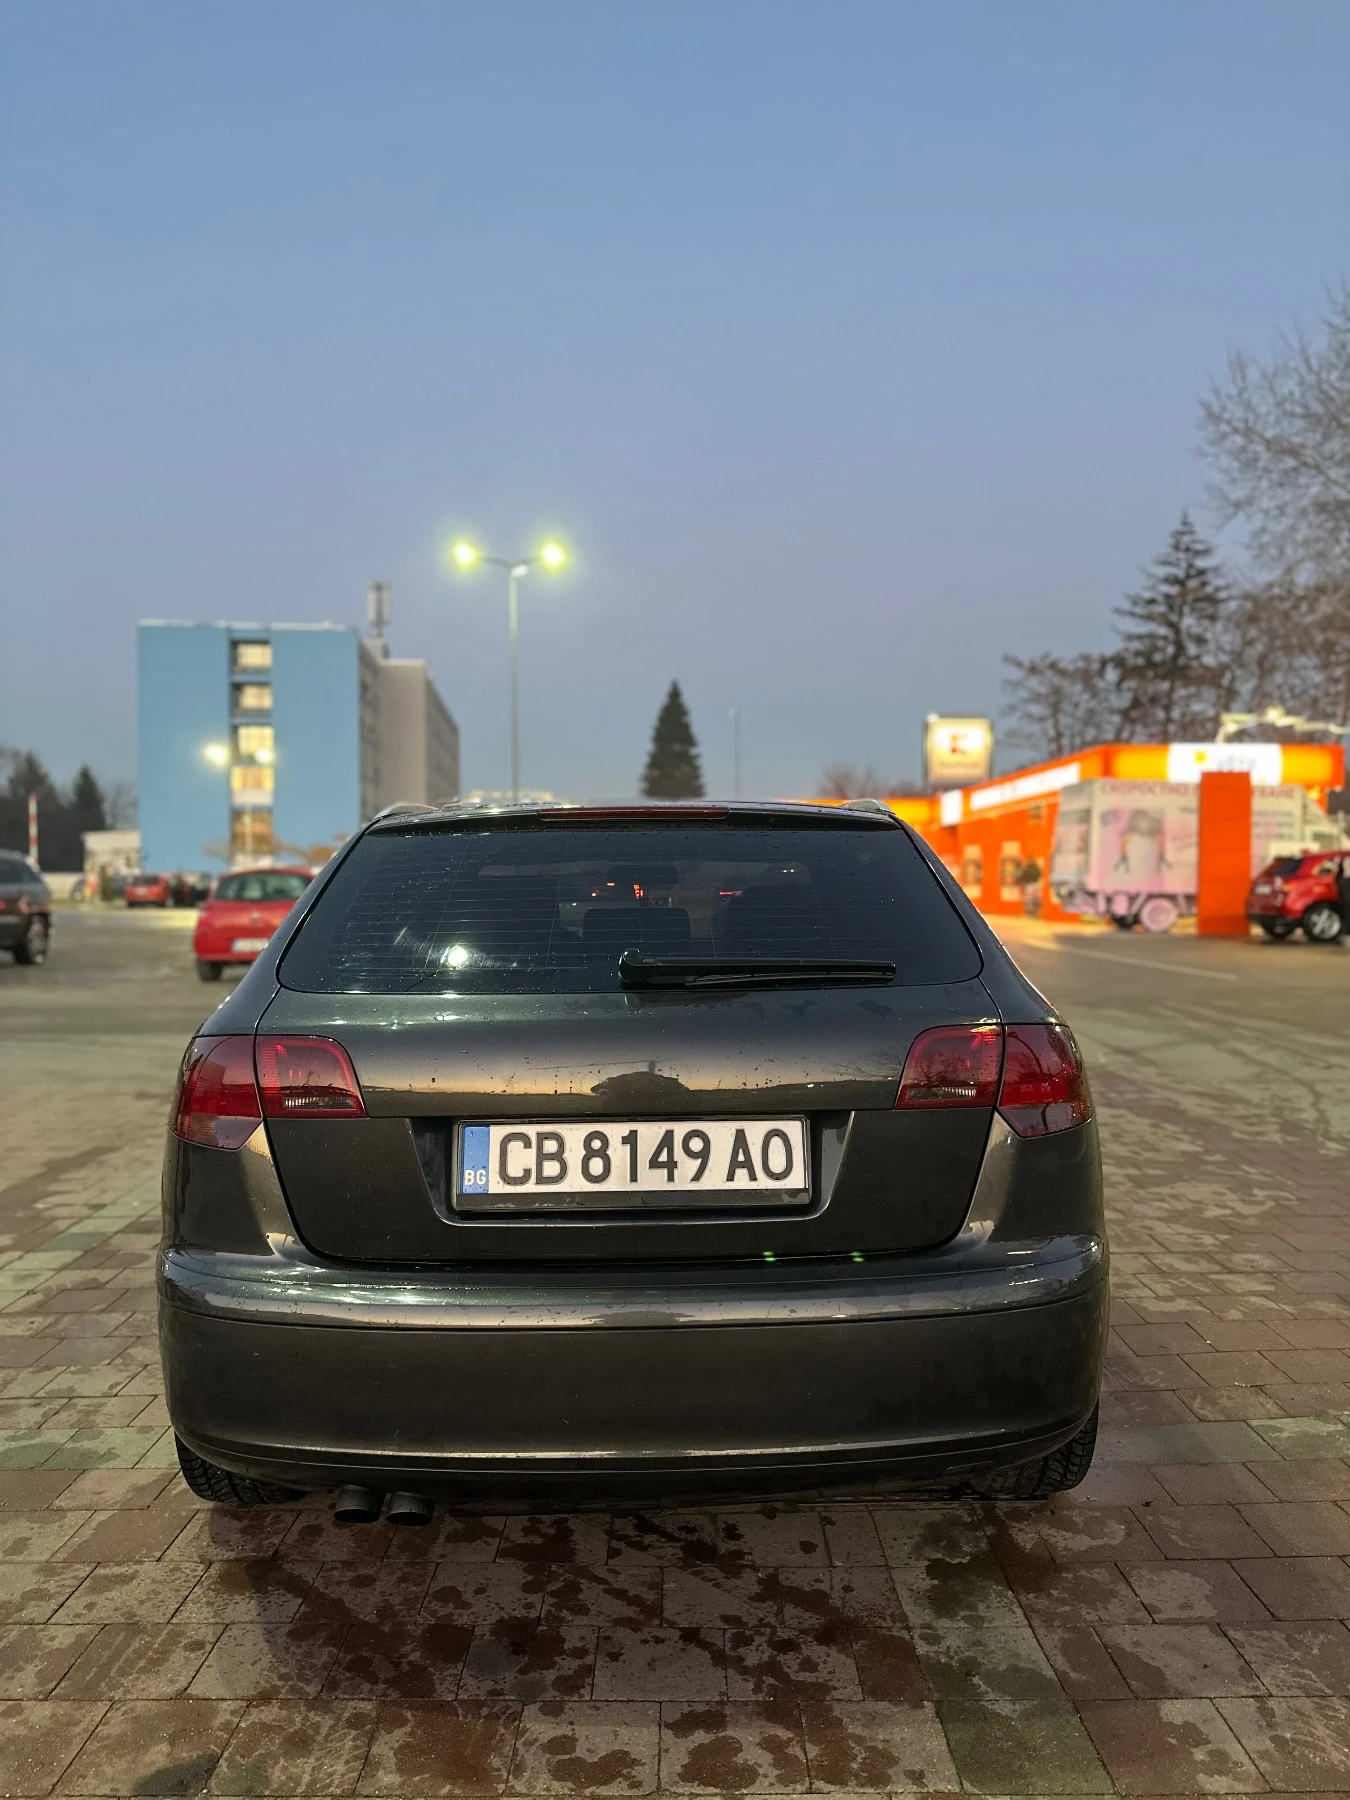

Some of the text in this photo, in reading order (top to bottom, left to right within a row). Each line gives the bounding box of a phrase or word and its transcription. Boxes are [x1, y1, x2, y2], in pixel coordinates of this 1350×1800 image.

[499, 1128, 794, 1186] CB 8149 AO
[464, 1169, 487, 1186] BG
